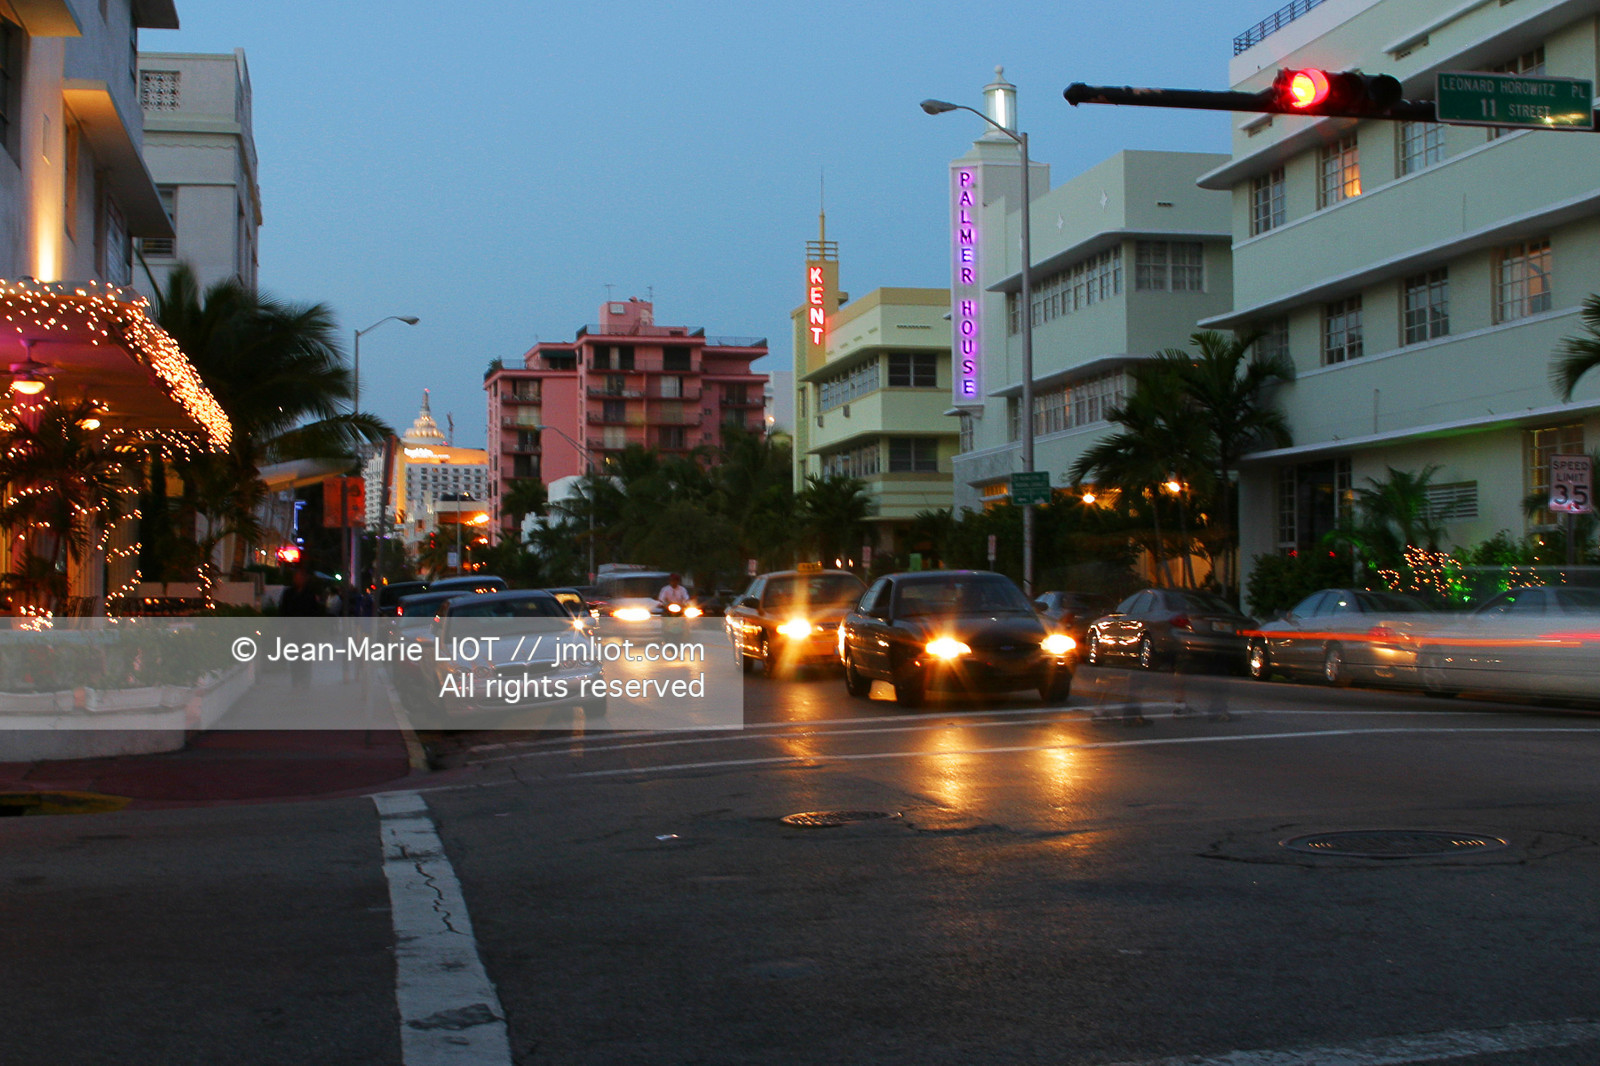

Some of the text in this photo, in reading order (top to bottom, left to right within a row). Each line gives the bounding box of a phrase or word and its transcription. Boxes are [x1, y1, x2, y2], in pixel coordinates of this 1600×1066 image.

[1441, 76, 1586, 98] LEONARD HOROWITZ PL
[1480, 98, 1551, 119] 11 STREET
[958, 170, 977, 396] PALMER HOUSE
[809, 266, 825, 345] KENT
[1552, 460, 1589, 471] SPEED
[1556, 472, 1585, 482] LIMIT
[1554, 484, 1589, 506] 35
